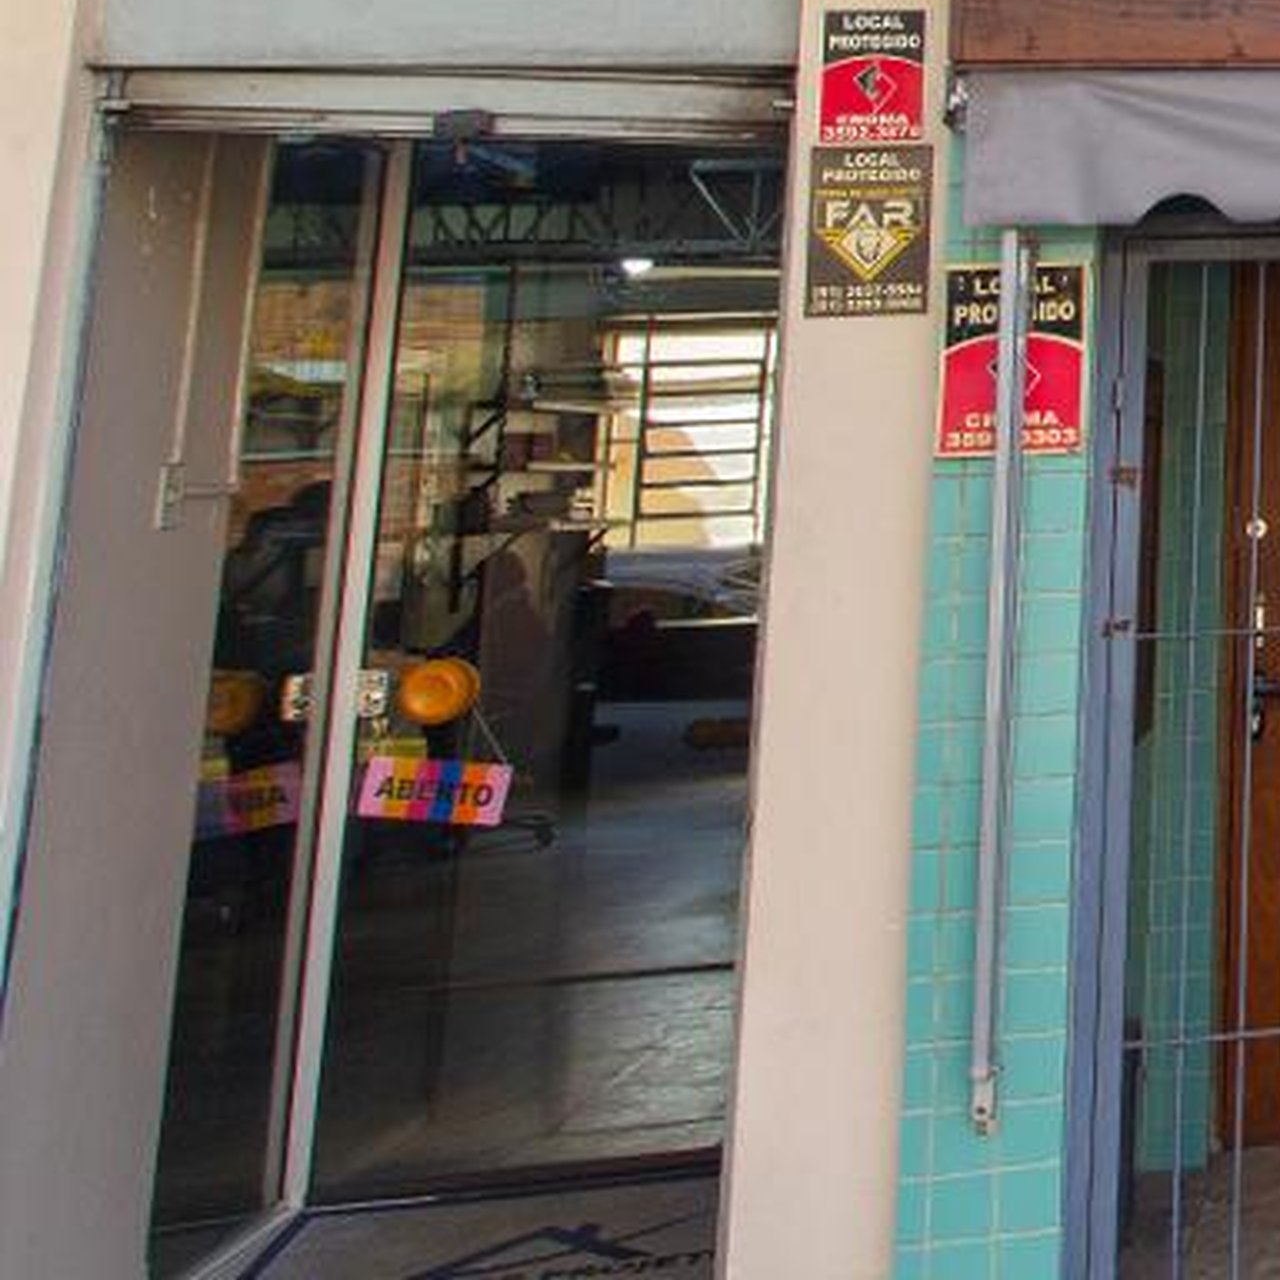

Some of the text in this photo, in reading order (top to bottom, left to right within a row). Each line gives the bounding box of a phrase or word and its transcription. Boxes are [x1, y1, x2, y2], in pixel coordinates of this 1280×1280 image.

[842, 14, 905, 31] LOCAL
[828, 32, 922, 52] PROTEGIDO
[844, 152, 901, 169] LOCAL
[821, 168, 922, 184] PROTEGIDO
[825, 200, 915, 230] FAR
[953, 300, 1077, 326] PROIDO
